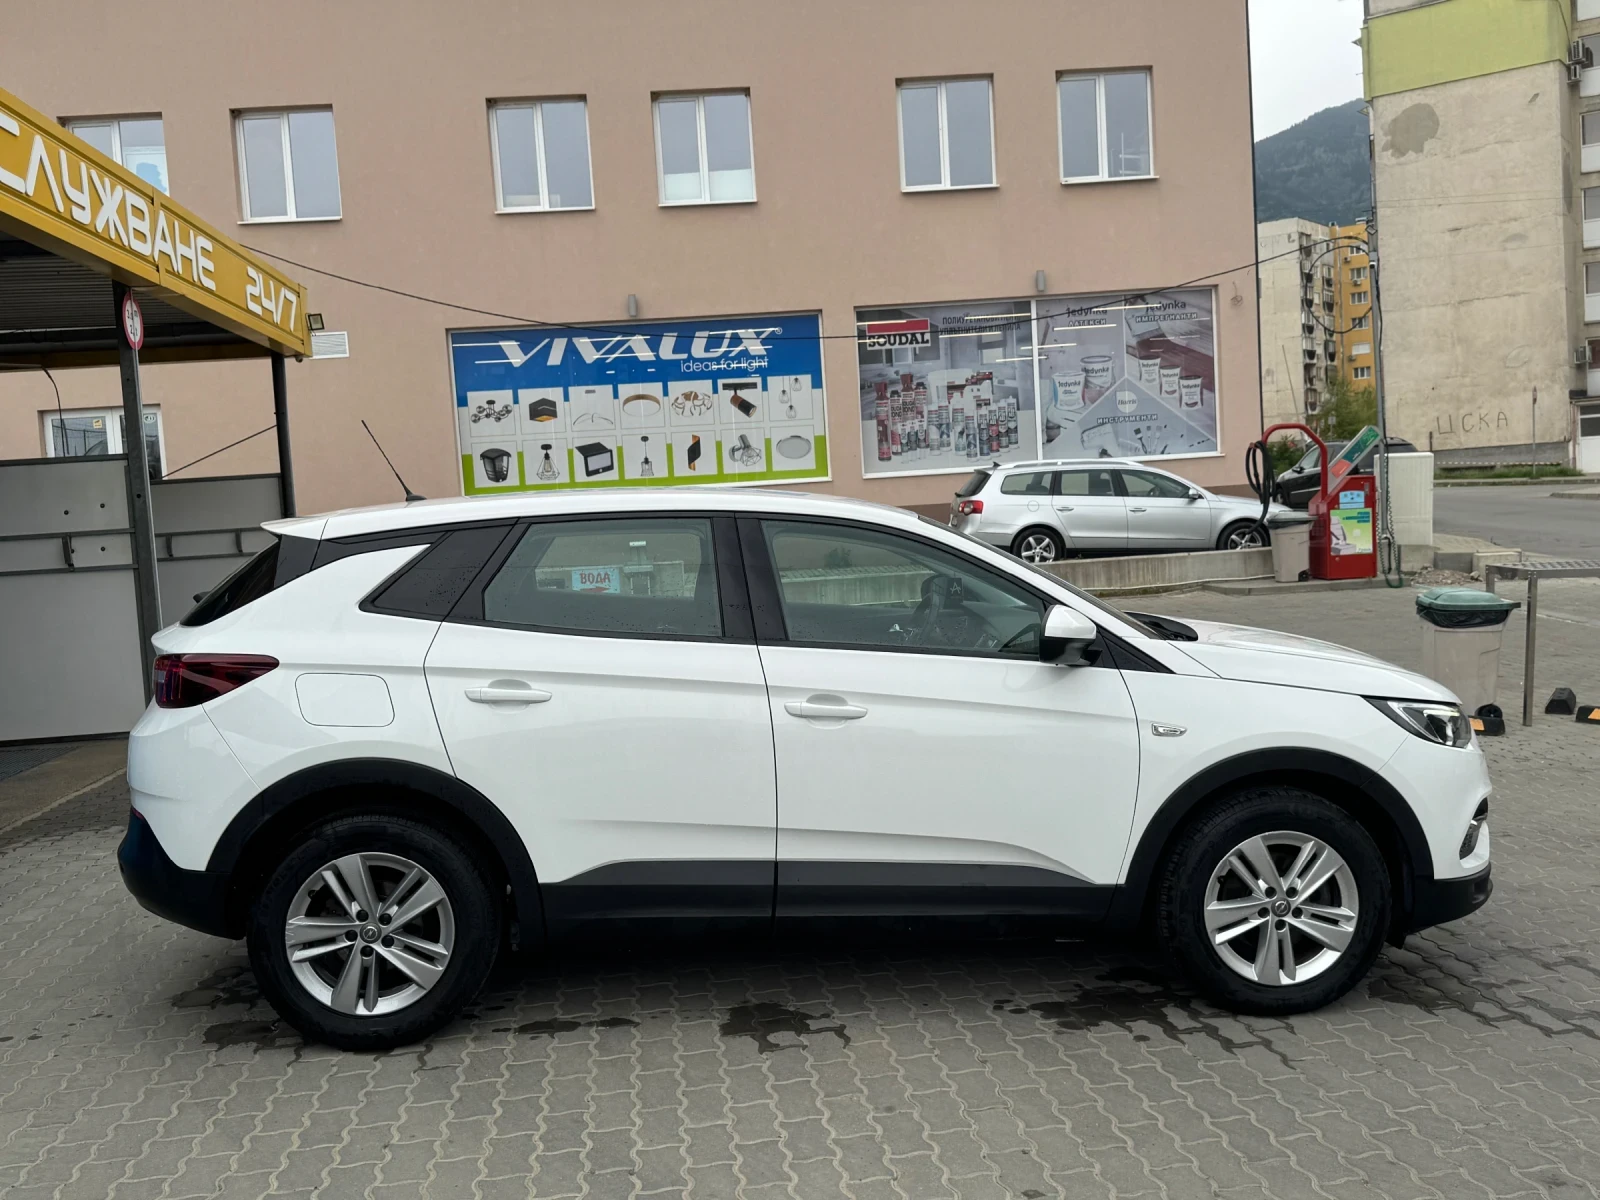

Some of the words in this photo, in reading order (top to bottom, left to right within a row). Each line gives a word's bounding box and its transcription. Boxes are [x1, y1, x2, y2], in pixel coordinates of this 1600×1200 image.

[245, 265, 297, 332] 24/7
[1068, 318, 1107, 328] ЛАТЕКСИ
[1135, 312, 1198, 323] ИМПРЕГНАНТИ
[868, 331, 929, 347] SOUDAL
[680, 360, 718, 373] ideas
[720, 358, 738, 370] for
[741, 356, 769, 372] light
[1097, 414, 1158, 425] ИНСТРУМЕНТИ
[1436, 411, 1508, 435] ЦСКА
[579, 572, 611, 585] ВОДА
